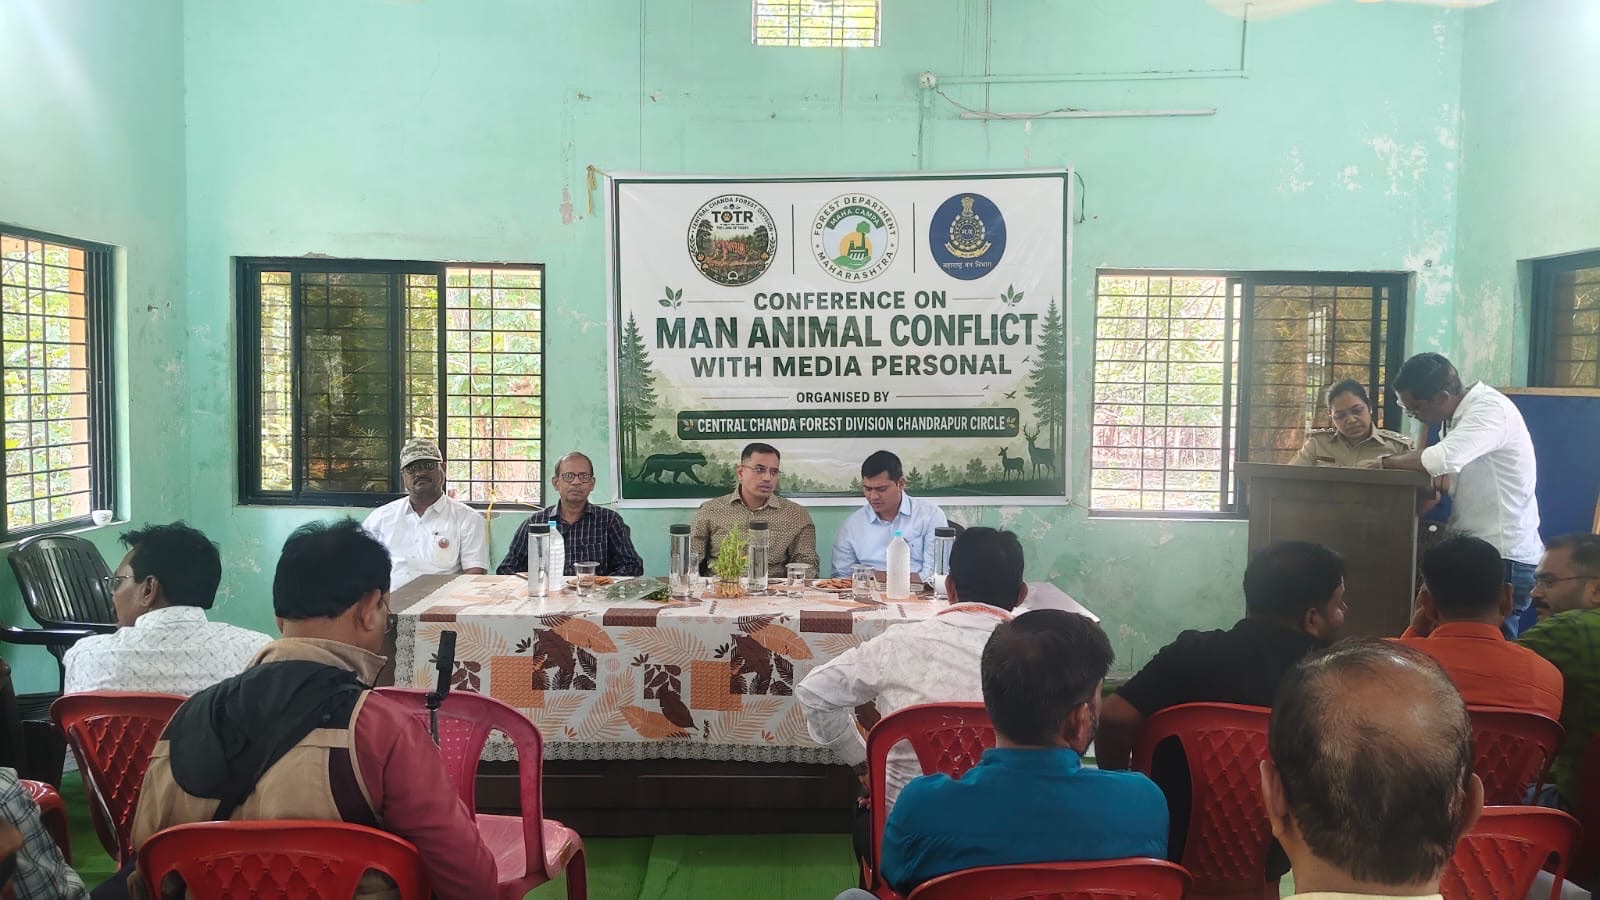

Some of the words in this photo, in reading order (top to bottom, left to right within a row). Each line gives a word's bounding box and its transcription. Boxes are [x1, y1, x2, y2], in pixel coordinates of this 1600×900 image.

[692, 208, 709, 230] CENTRAL
[708, 197, 733, 209] CHANDA
[735, 197, 757, 209] FOREST
[757, 207, 774, 232] DIVISION
[711, 210, 753, 223] TOTR
[814, 200, 840, 236] FOREST
[843, 196, 896, 235] DEPARTMENT
[830, 209, 853, 226] MAHA
[855, 208, 880, 225] CAMPA
[817, 251, 894, 280] MAHARASHTRA
[753, 291, 906, 311] CONFERENCE
[914, 290, 946, 309] ON
[656, 316, 738, 349] MAN
[747, 315, 882, 349] ANIMAL
[889, 313, 1038, 347] CONFLICT
[690, 356, 762, 378] WITH
[773, 355, 862, 377] MEDIA
[871, 354, 1012, 376] PERSONAL
[796, 391, 870, 403] ORGANISED
[873, 391, 890, 403] BY
[697, 418, 747, 433] CENTRAL
[749, 417, 797, 433] CHANDA
[800, 416, 843, 432] FOREST
[845, 416, 894, 431] DIVISION
[896, 416, 968, 431] CHANDRAPUR
[970, 415, 1006, 431] CIRCLE
